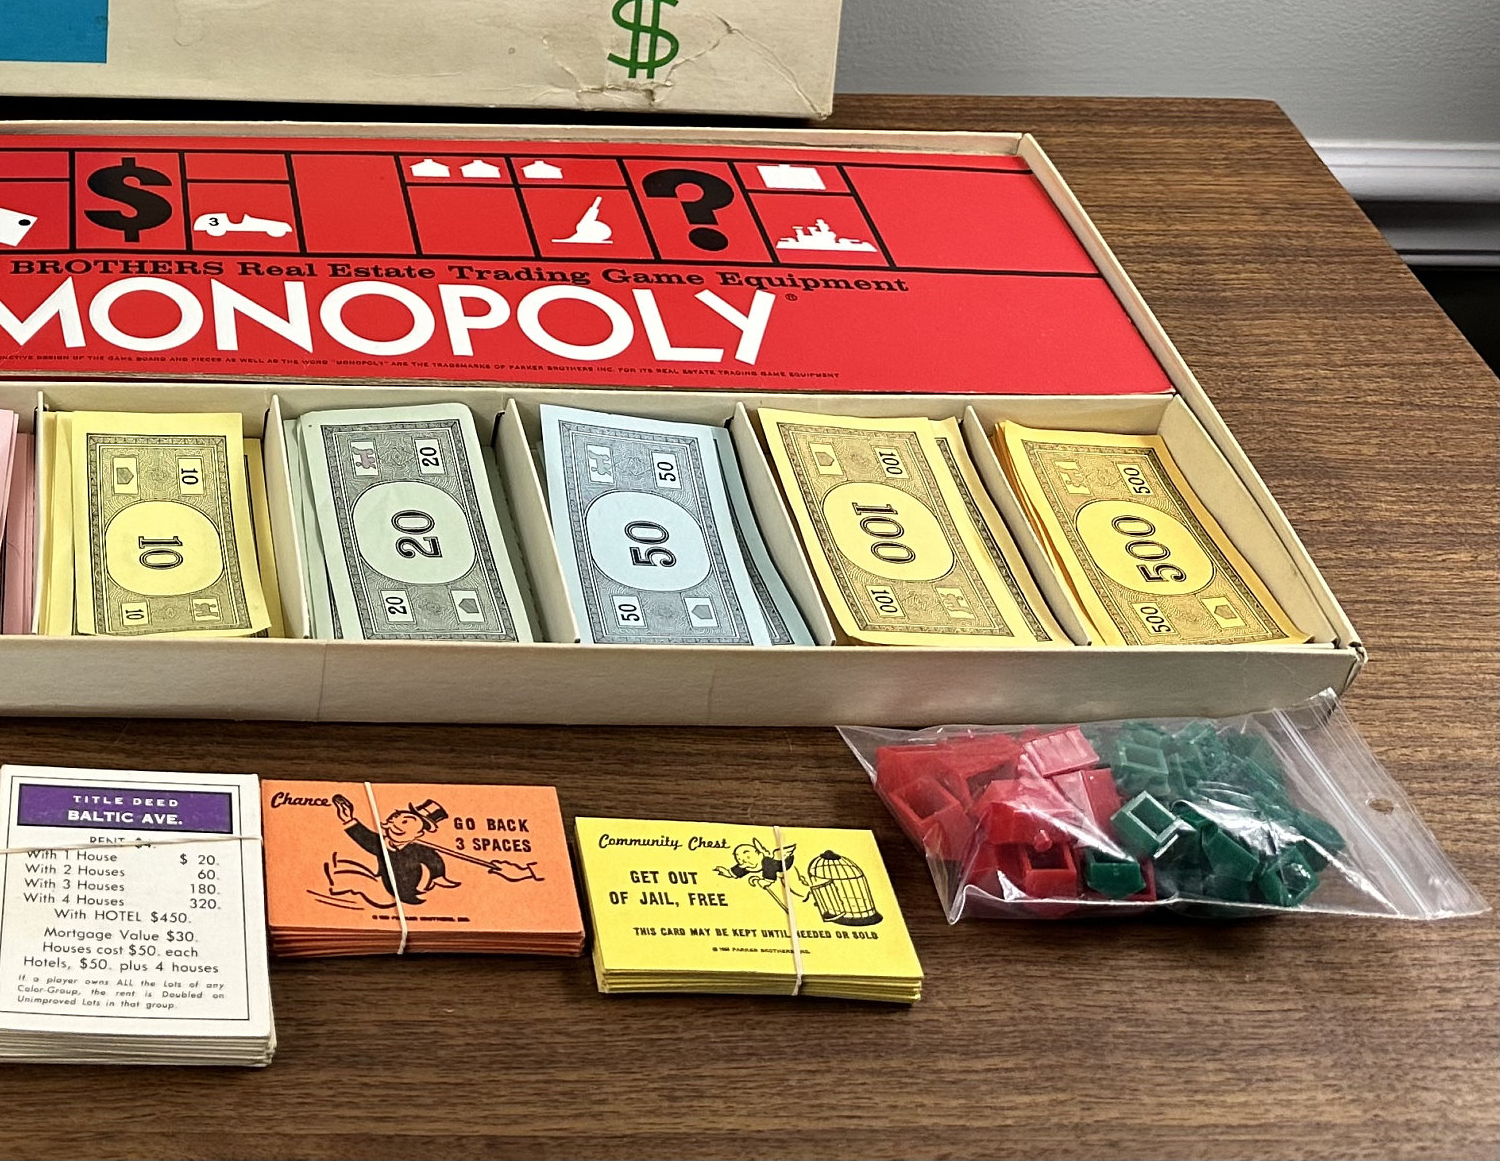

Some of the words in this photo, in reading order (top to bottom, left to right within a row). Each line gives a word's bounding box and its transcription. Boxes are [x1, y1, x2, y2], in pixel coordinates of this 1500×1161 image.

[10, 259, 223, 275] BROTHERS
[237, 262, 317, 276] Real
[327, 264, 435, 278] Estate
[448, 266, 591, 287] Trading
[602, 269, 704, 285] Game
[716, 272, 909, 292] Equipment
[391, 510, 442, 558] 20
[852, 502, 916, 564] 100
[624, 521, 676, 567] 50
[1111, 515, 1186, 582] 500
[138, 536, 183, 570] 10
[73, 796, 123, 804] TITLE
[133, 798, 178, 806] DEED
[271, 792, 331, 808] Chance
[68, 810, 133, 822] BALTIC
[142, 814, 182, 824] AVE.
[454, 817, 475, 830] GO
[487, 818, 529, 832] BACK
[456, 838, 464, 850] 3
[473, 838, 531, 852] SPACES
[599, 834, 682, 850] Community
[688, 836, 730, 851] Chest
[25, 864, 56, 874] With
[64, 865, 71, 874] 2
[78, 865, 125, 876] Houses
[630, 871, 659, 883] GET
[668, 871, 697, 884] OUT
[609, 891, 628, 904] OF
[640, 892, 679, 907] JAIL,
[688, 893, 728, 906] FREE
[54, 909, 86, 919] With
[95, 910, 141, 921] HOTEL
[151, 911, 191, 923] $450.
[44, 927, 112, 941] Mortgage
[120, 930, 159, 941] Value
[661, 928, 685, 936] CARD
[690, 928, 710, 936] MAY
[715, 928, 728, 936] BE
[732, 929, 756, 937] KEPT
[761, 930, 791, 938] UNTIL
[836, 931, 849, 939] OR
[43, 942, 91, 954] Houses
[97, 946, 123, 955] cost
[166, 947, 198, 957] each
[24, 956, 70, 970] Hotels,
[120, 960, 148, 973] plus
[156, 962, 163, 971] 4
[172, 962, 218, 973] houses
